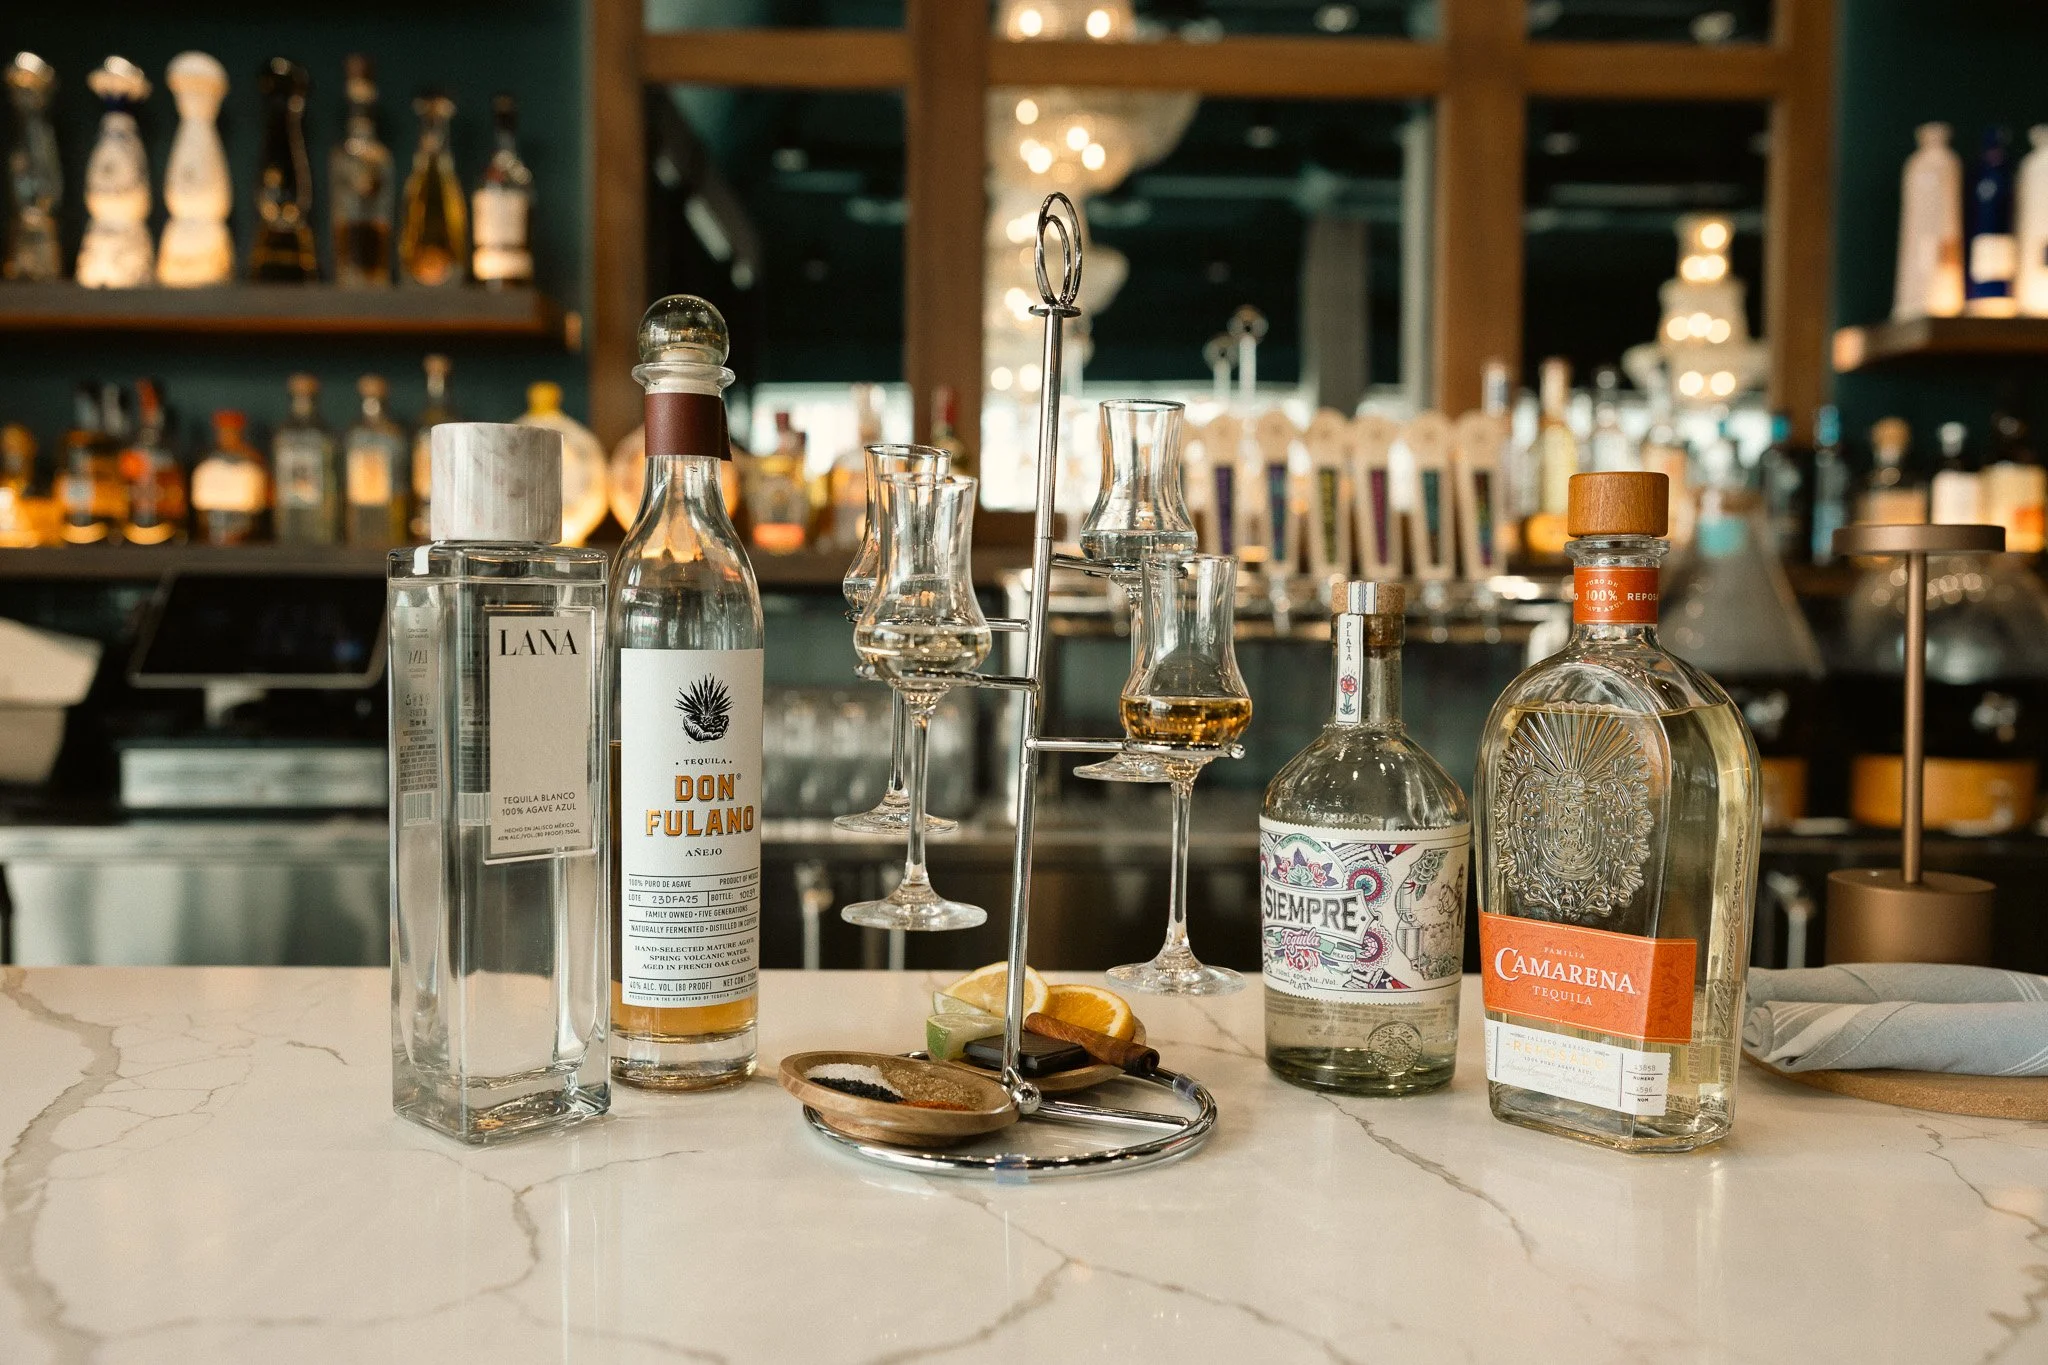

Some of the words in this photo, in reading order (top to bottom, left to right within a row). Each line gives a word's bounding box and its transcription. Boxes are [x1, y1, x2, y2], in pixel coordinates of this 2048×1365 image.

[1585, 589, 1618, 601] 100%
[1627, 592, 1659, 601] REPOS
[498, 628, 581, 657] LANA
[684, 758, 727, 766] TEQUILA
[503, 795, 539, 805] TEQUILA
[541, 791, 576, 802] BLANCO
[501, 808, 524, 816] 100%
[526, 805, 553, 815] AGAVE
[555, 802, 577, 812] AZUL
[645, 805, 754, 837] FULANO
[1299, 835, 1316, 848] AGAVE
[685, 847, 723, 858] AÑEJO
[629, 878, 643, 887] 100%
[644, 879, 661, 888] PURO
[662, 880, 670, 888] DE
[671, 880, 692, 888] AGAVE
[719, 875, 742, 886] PRODUCT
[742, 874, 748, 882] OF
[651, 895, 699, 905] 23DFA25
[711, 892, 734, 901] BOTTLE:
[645, 910, 668, 918] FAMILY
[668, 911, 694, 919] OWNED
[698, 909, 713, 918] FIVE
[713, 904, 748, 917] GENERATIONS
[1264, 883, 1360, 934] SIEMPRE
[630, 924, 664, 935] NATURALLY
[665, 925, 705, 934] FERMENTED
[709, 921, 737, 932] DISTILLED
[738, 919, 743, 928] IN
[634, 944, 704, 953] HAND-SELECTED
[706, 941, 737, 951] MATURE
[1543, 946, 1586, 960] FAMILIA
[649, 954, 681, 962] SPRING
[683, 952, 725, 961] VOLCANIC
[1332, 951, 1355, 961] MEXICO
[641, 962, 664, 970] AGED
[678, 962, 713, 970] FRENCH
[731, 955, 752, 965] CASKS
[629, 980, 642, 990] 40%
[643, 982, 657, 991] ALC.
[658, 983, 674, 992] VOL.
[723, 978, 733, 988] NET
[1289, 979, 1312, 991] PLATA
[1532, 985, 1594, 1006] TEQUILA
[1527, 1035, 1558, 1047] JALISCO
[1512, 1040, 1608, 1071] REPOSADO
[1557, 1062, 1576, 1073] AGAVE
[1577, 1068, 1594, 1077] AZUL
